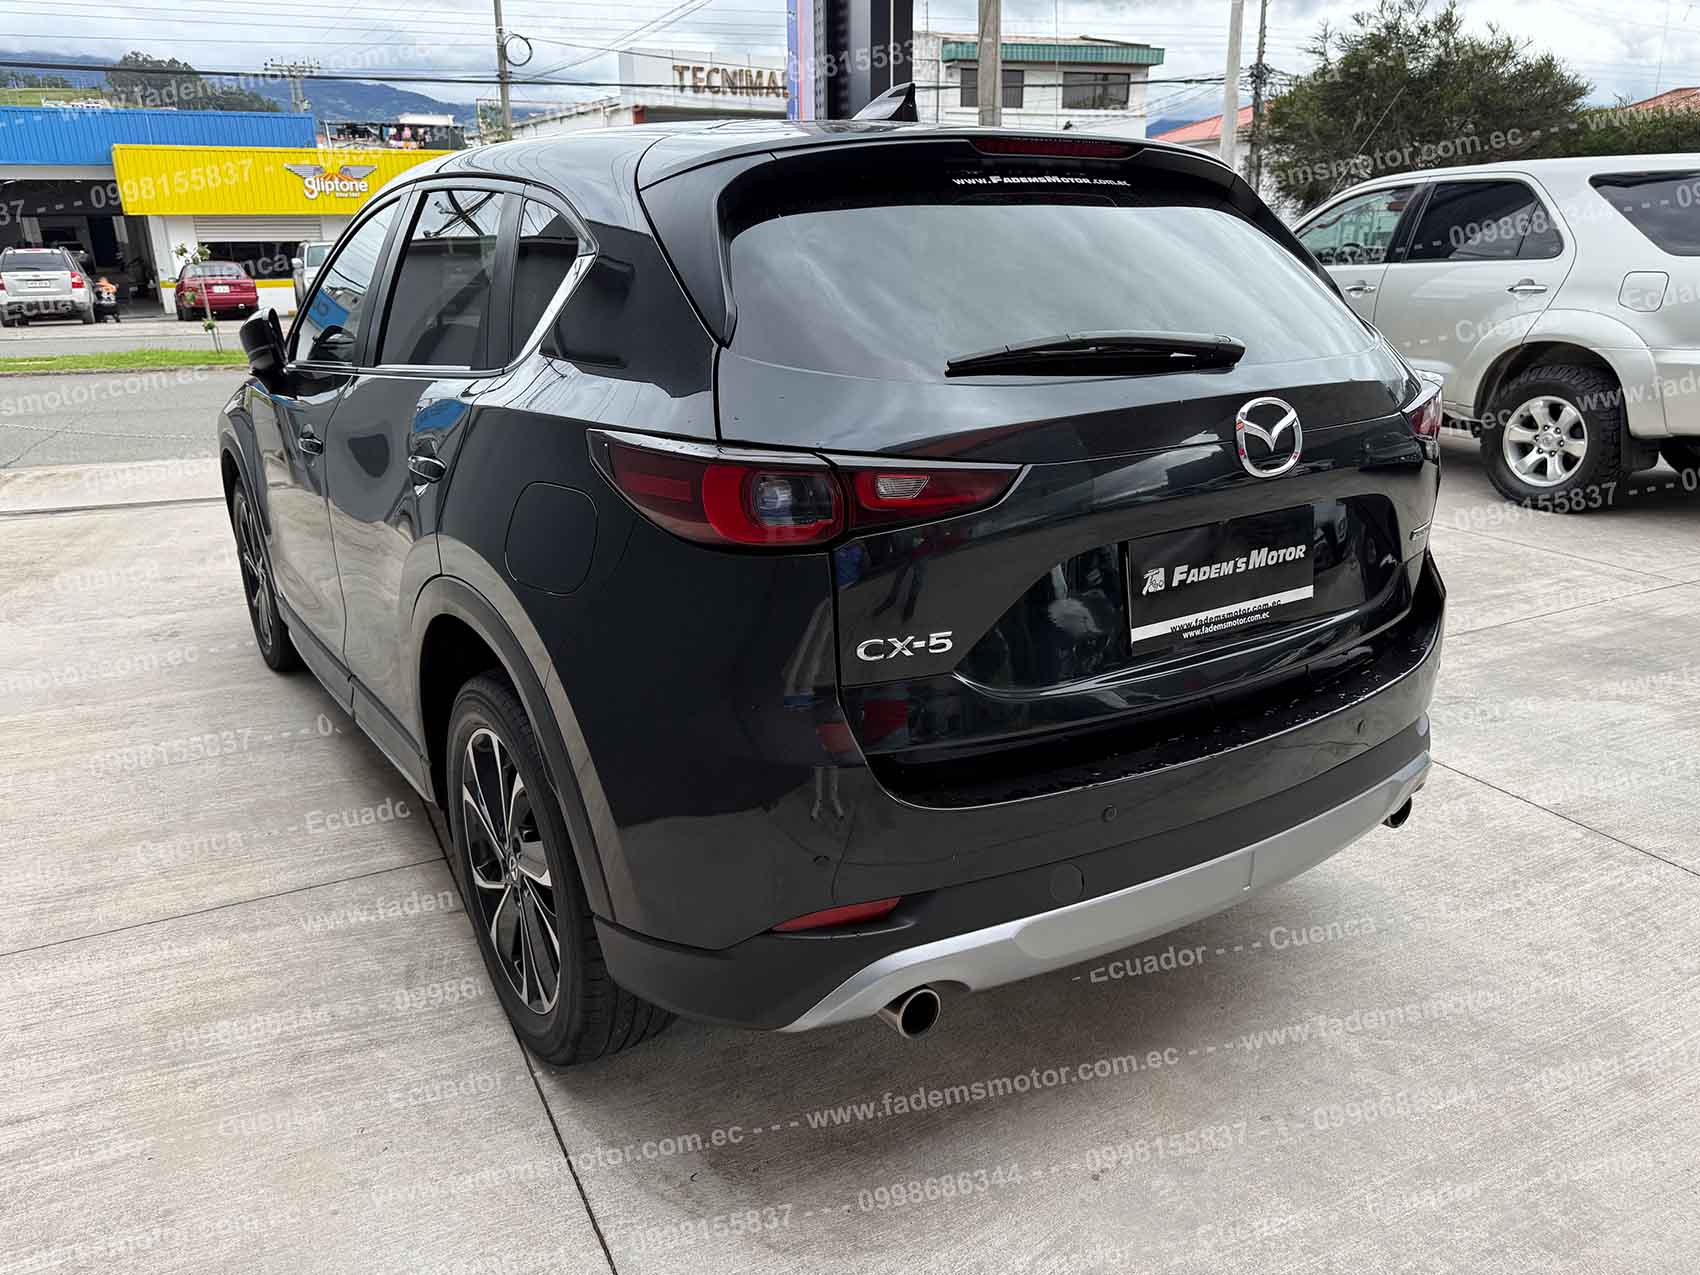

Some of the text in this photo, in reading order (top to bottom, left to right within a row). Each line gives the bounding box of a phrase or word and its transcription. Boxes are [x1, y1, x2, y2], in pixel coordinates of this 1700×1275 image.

[672, 65, 788, 98] TECNIMA
[1248, 544, 1306, 571] MOTOR
[855, 631, 953, 663] CX-5
